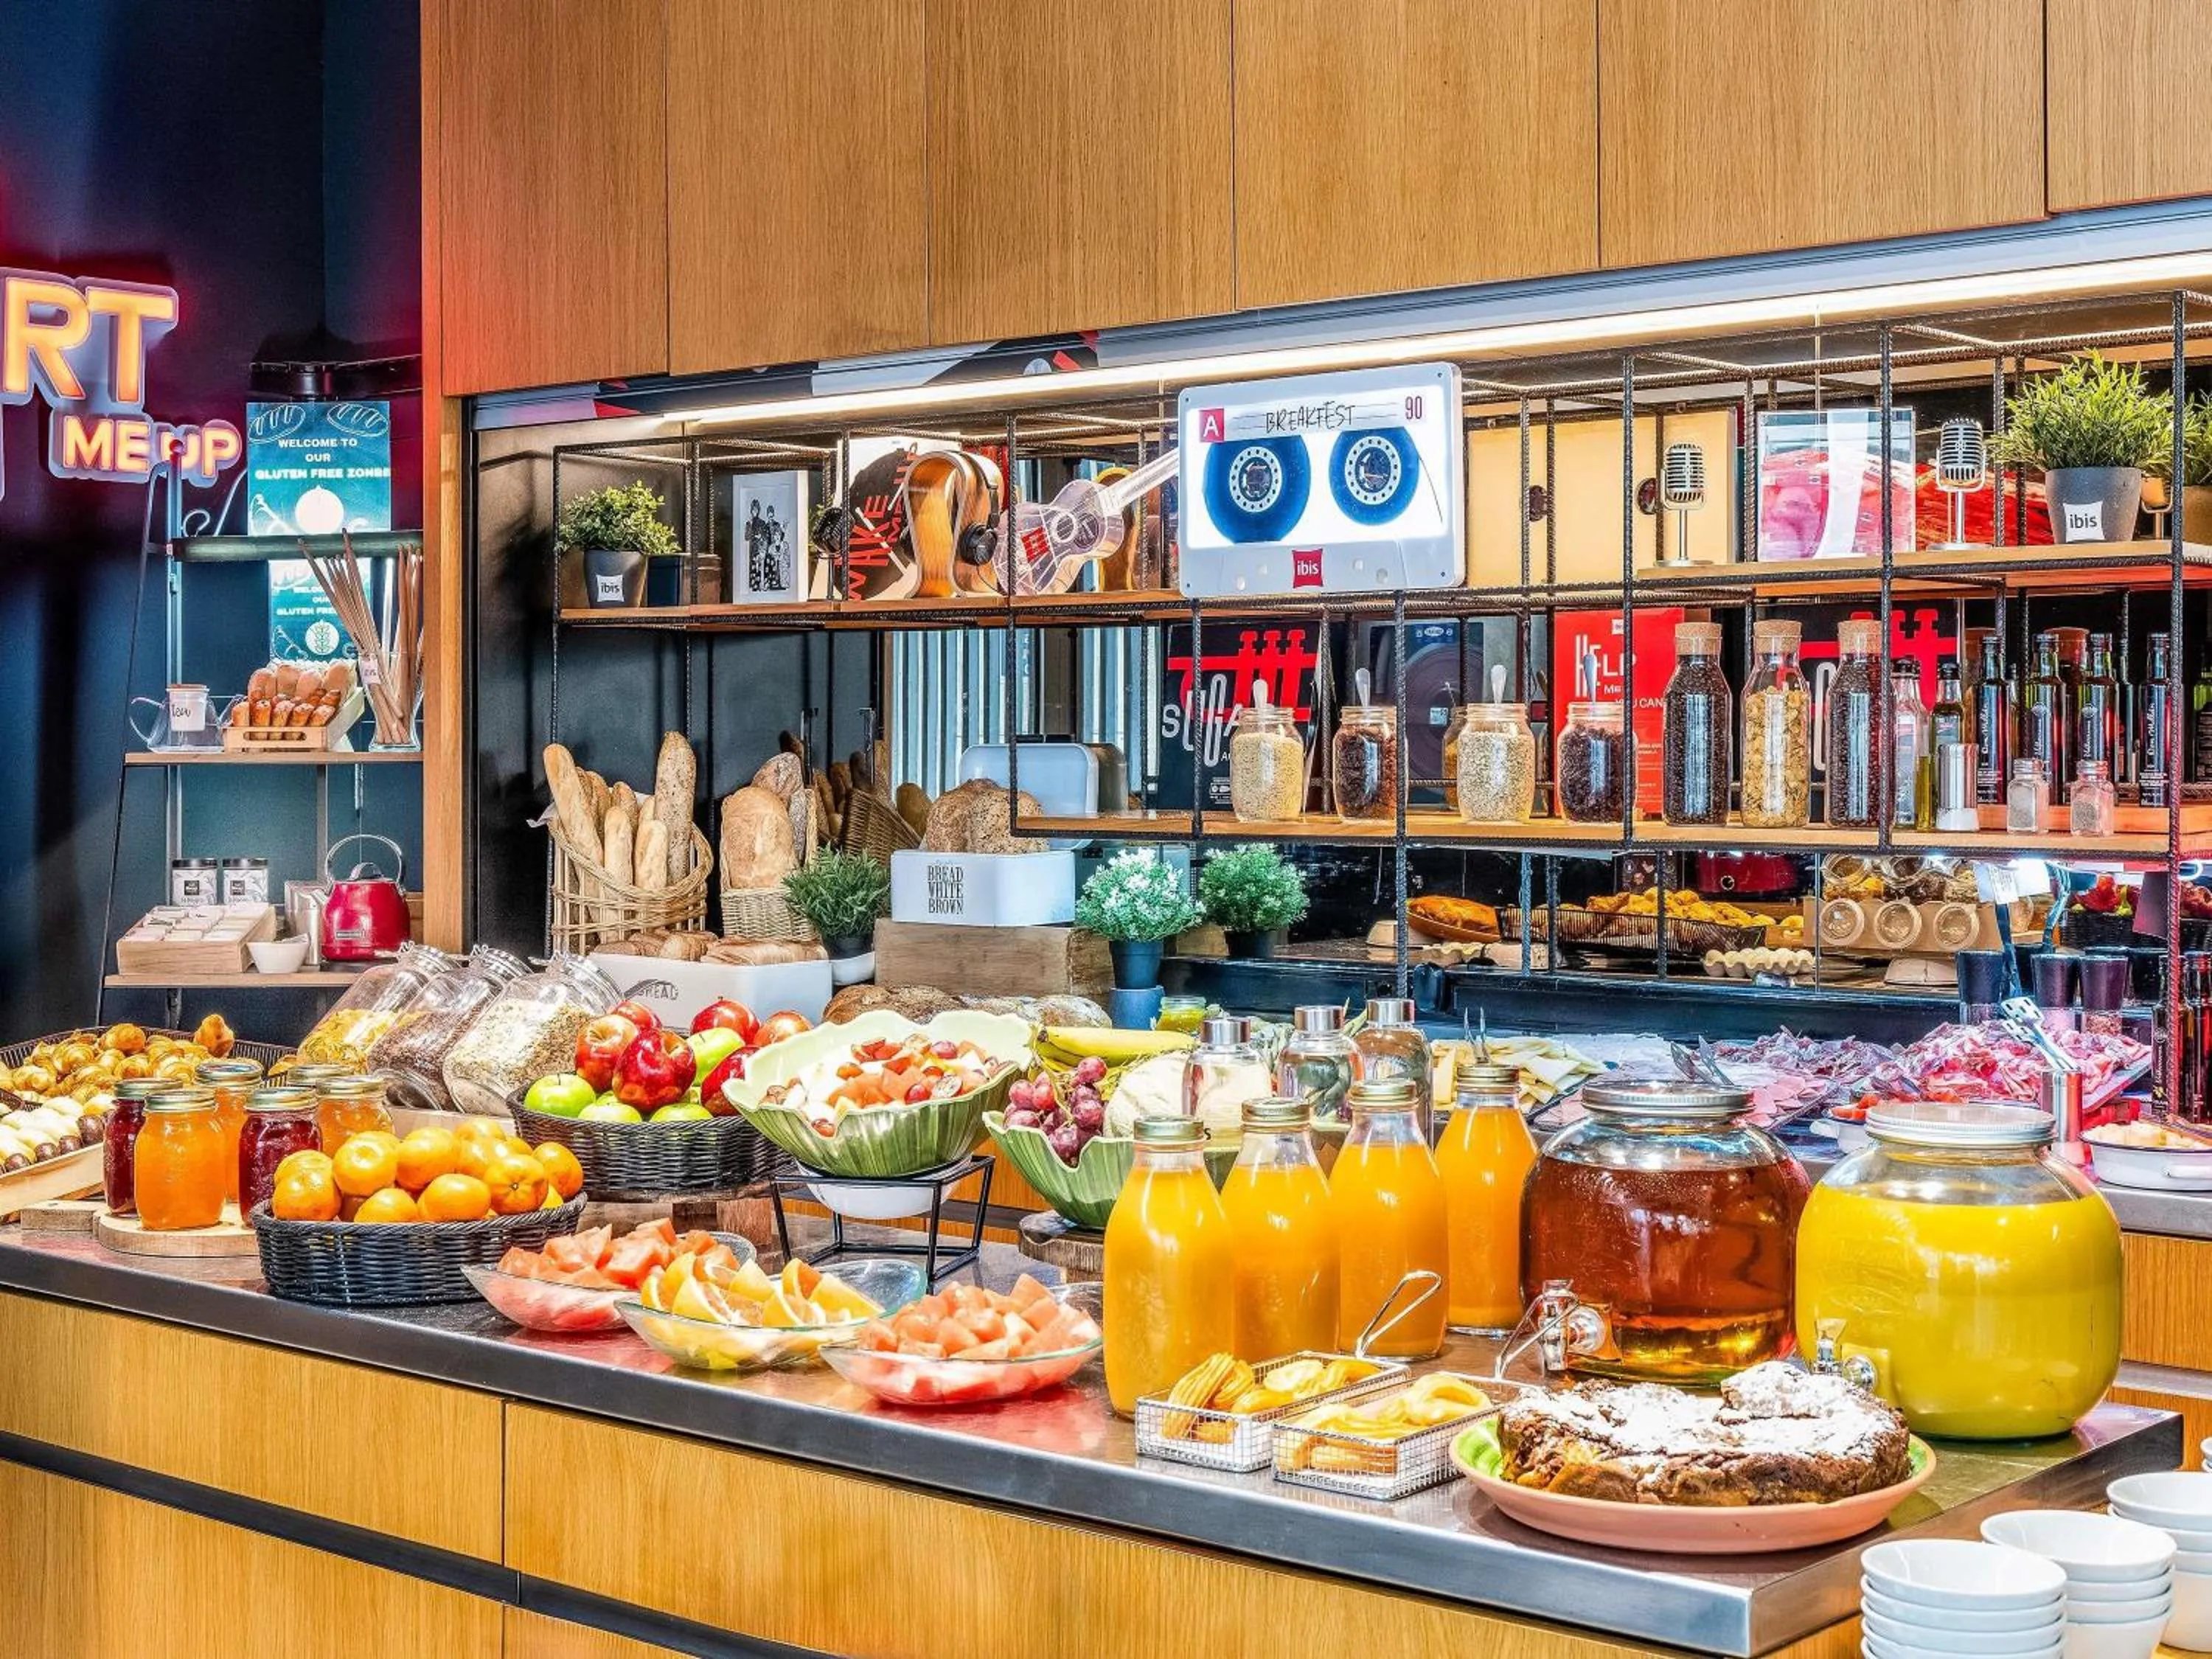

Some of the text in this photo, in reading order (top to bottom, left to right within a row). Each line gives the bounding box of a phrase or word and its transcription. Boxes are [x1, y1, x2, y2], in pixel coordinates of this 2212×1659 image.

[1405, 395, 1423, 420] 90
[1266, 400, 1356, 434] BREAKFEST
[1203, 416, 1219, 437] A
[63, 415, 150, 473] ME
[277, 437, 358, 448] WELCOME TO
[305, 453, 332, 462] OUR
[254, 468, 308, 480] GLUTEN
[310, 468, 344, 479] FREE
[2069, 512, 2098, 529] ibis
[1297, 560, 1319, 576] ibis
[600, 582, 620, 594] ibis
[927, 864, 964, 882] BREAD
[927, 881, 964, 899] WHITE
[928, 897, 964, 915] BROWN
